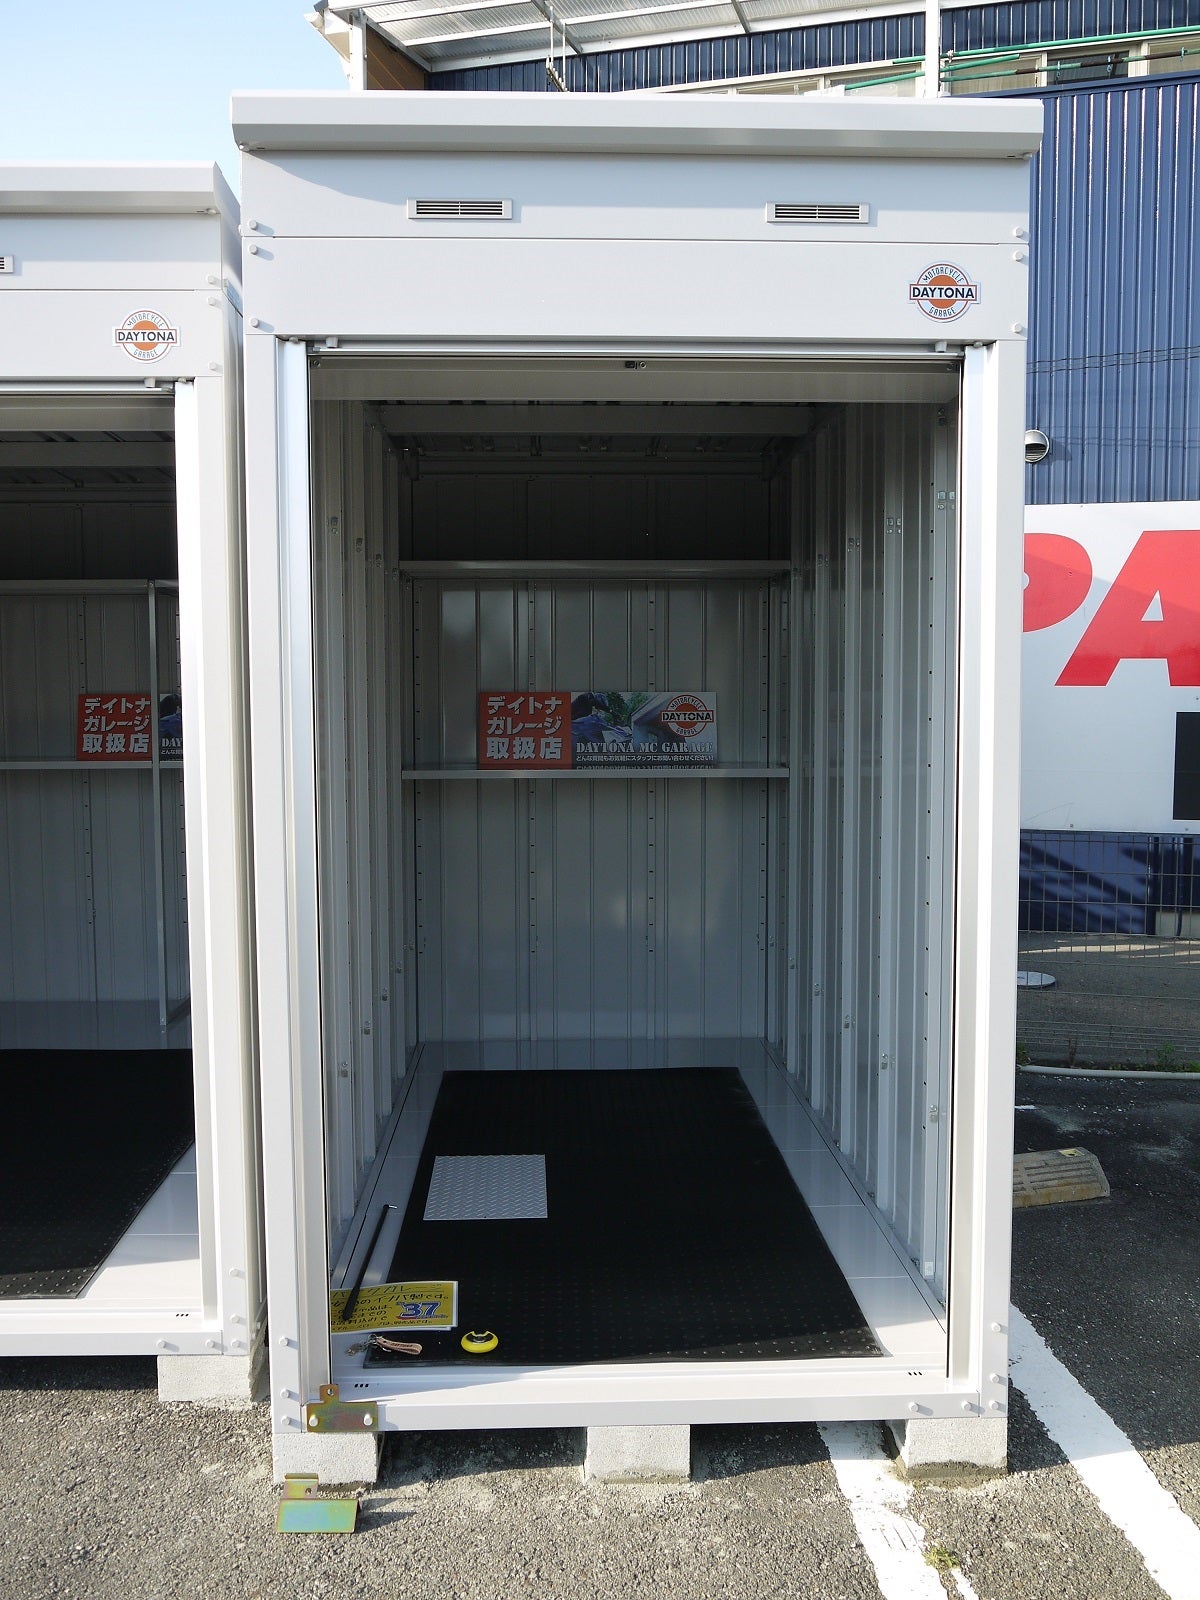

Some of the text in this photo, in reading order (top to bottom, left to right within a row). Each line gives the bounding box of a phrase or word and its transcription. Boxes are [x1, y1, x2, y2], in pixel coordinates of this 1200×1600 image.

[922, 266, 964, 283] MOTORCYCLE
[912, 287, 975, 299] DAYTONA
[127, 312, 165, 328] MOTORCYCLE
[928, 306, 957, 318] GARAGE
[118, 331, 175, 342] DAYTONA
[133, 349, 159, 359] GARAGE
[84, 697, 151, 714] デイトナ
[486, 695, 562, 715] デイトナ
[84, 715, 150, 732] ガレージ
[662, 712, 712, 721] DAYTONA
[487, 716, 562, 735] ガレージ
[82, 733, 150, 754] 取扱店
[486, 736, 562, 760] 取扱店
[576, 742, 714, 753] DAYTONA MC GARAGE
[400, 1301, 441, 1318] 37
